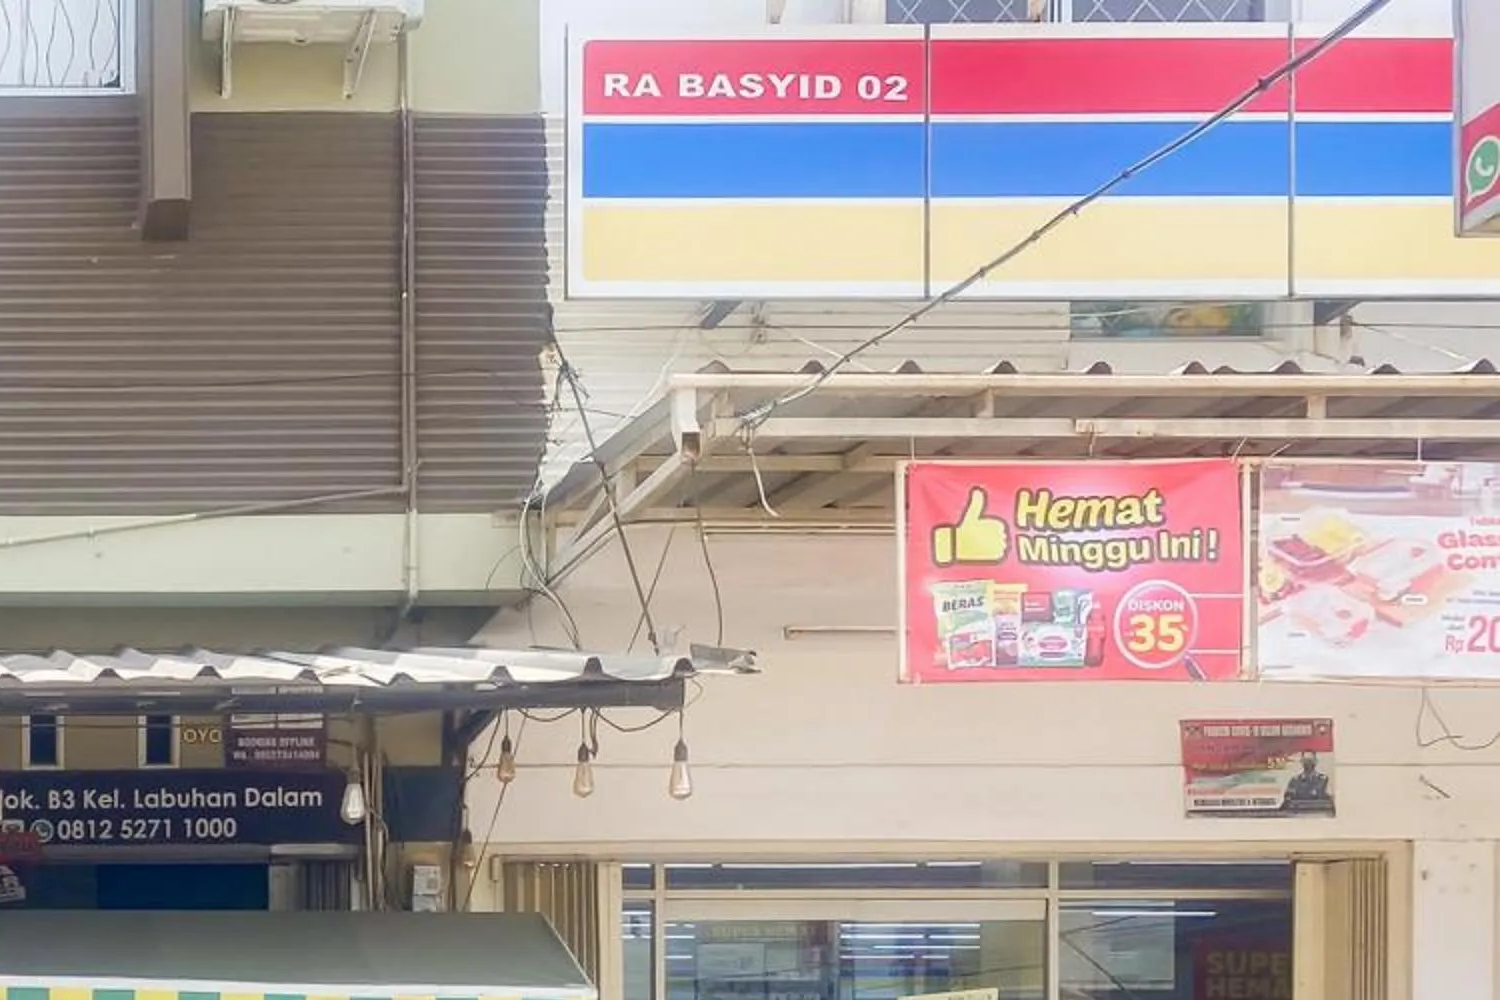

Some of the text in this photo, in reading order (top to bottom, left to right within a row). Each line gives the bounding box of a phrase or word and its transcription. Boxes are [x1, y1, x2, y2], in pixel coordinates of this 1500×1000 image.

[603, 72, 909, 101] RA BASYID 02
[1016, 489, 1164, 529] Hemat
[1017, 535, 1151, 569] Minggu
[1159, 530, 1202, 560] Ini
[942, 594, 985, 613] BERAS
[1127, 601, 1185, 612] DISKON
[183, 729, 222, 743] OYO
[49, 789, 75, 809] B3
[83, 788, 126, 809] Kel.
[134, 787, 237, 809] Labuhan
[244, 785, 323, 807] Dalam
[57, 819, 113, 840] 0812
[120, 818, 172, 839] 5271
[184, 817, 236, 838] 1000
